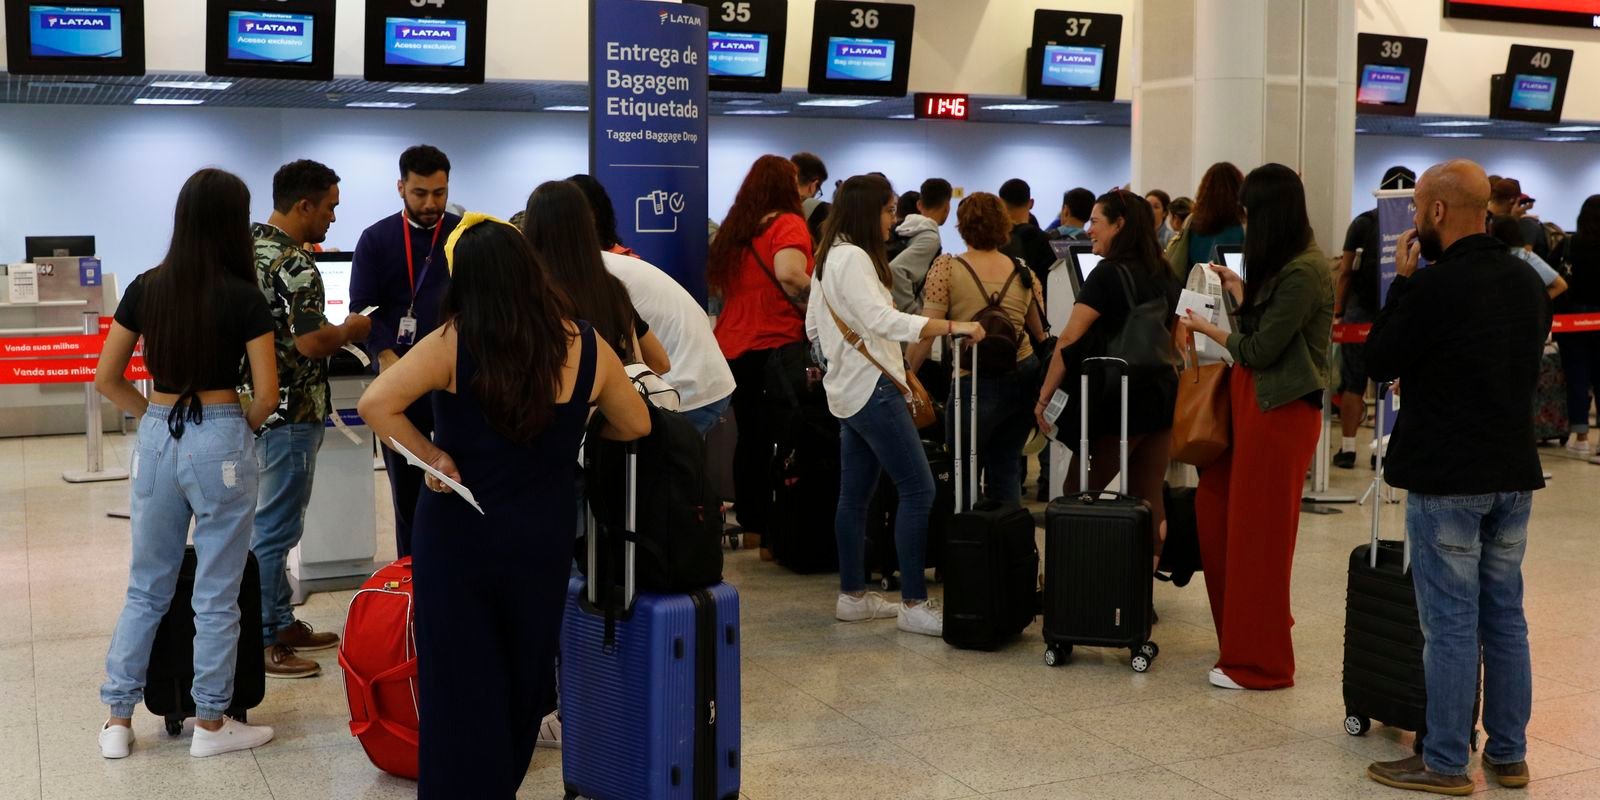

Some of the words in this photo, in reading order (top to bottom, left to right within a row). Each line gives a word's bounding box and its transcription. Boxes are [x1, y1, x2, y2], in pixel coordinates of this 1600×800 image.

[721, 1, 751, 22] 35
[60, 18, 104, 26] LATAM
[670, 14, 701, 26] LATAM
[850, 8, 879, 29] 36
[255, 23, 297, 32] LATAM
[411, 29, 451, 37] LATAM
[1065, 17, 1092, 36] 37
[238, 36, 266, 44] Acesso
[267, 38, 303, 46] exclusivo
[720, 42, 755, 50] LATAM
[606, 42, 680, 68] Entrega
[683, 45, 698, 65] de
[849, 47, 882, 55] LATAM
[1380, 40, 1403, 58] 39
[1062, 55, 1092, 63] LATAM
[1530, 51, 1551, 69] 40
[606, 69, 689, 95] Bagagem
[606, 97, 698, 122] Etiquetada
[927, 98, 965, 117] 11:46
[606, 129, 643, 142] Tagged
[645, 130, 681, 143] Baggage
[683, 131, 698, 144] Drop
[5, 344, 31, 352] Venda
[53, 342, 80, 350] milhas
[13, 367, 45, 376] Venda
[71, 367, 97, 375] milha
